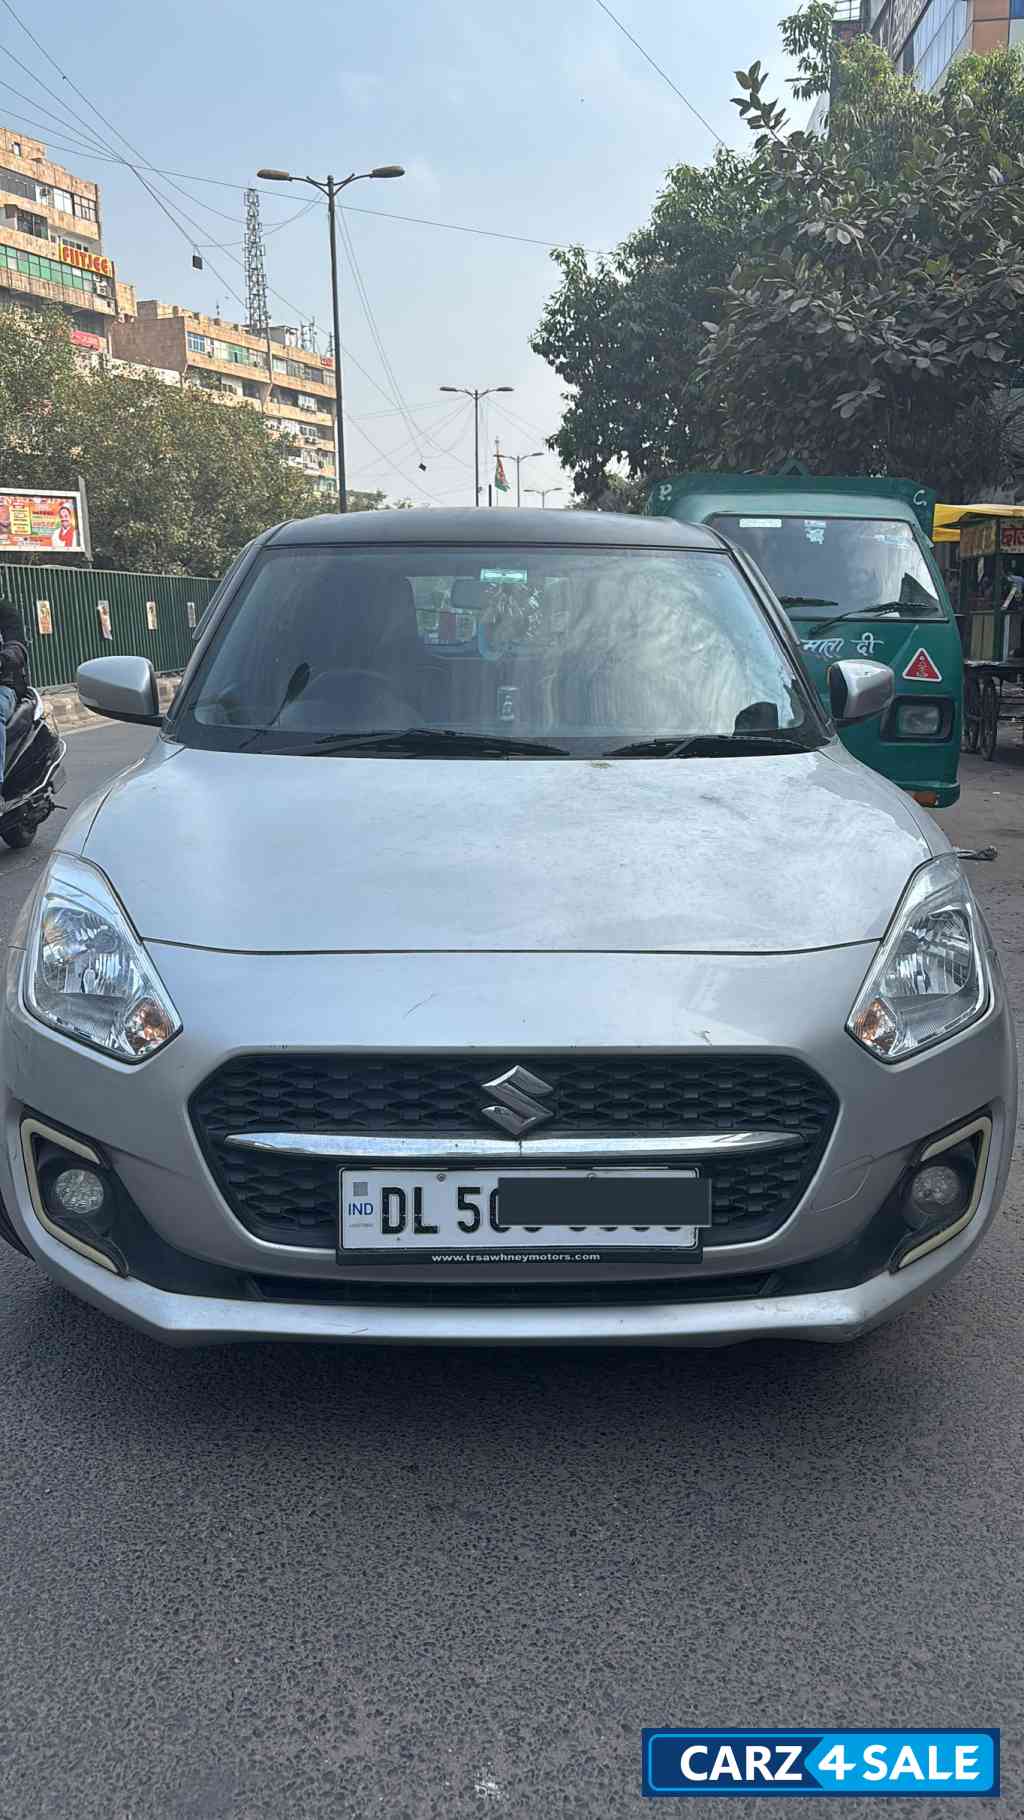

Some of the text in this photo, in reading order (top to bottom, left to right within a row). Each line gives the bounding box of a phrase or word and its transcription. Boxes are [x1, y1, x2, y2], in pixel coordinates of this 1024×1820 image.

[850, 632, 884, 656] दी
[348, 1203, 374, 1215] IND
[381, 1187, 438, 1234] DL
[431, 1253, 601, 1262] www.trsawhneymotors.com
